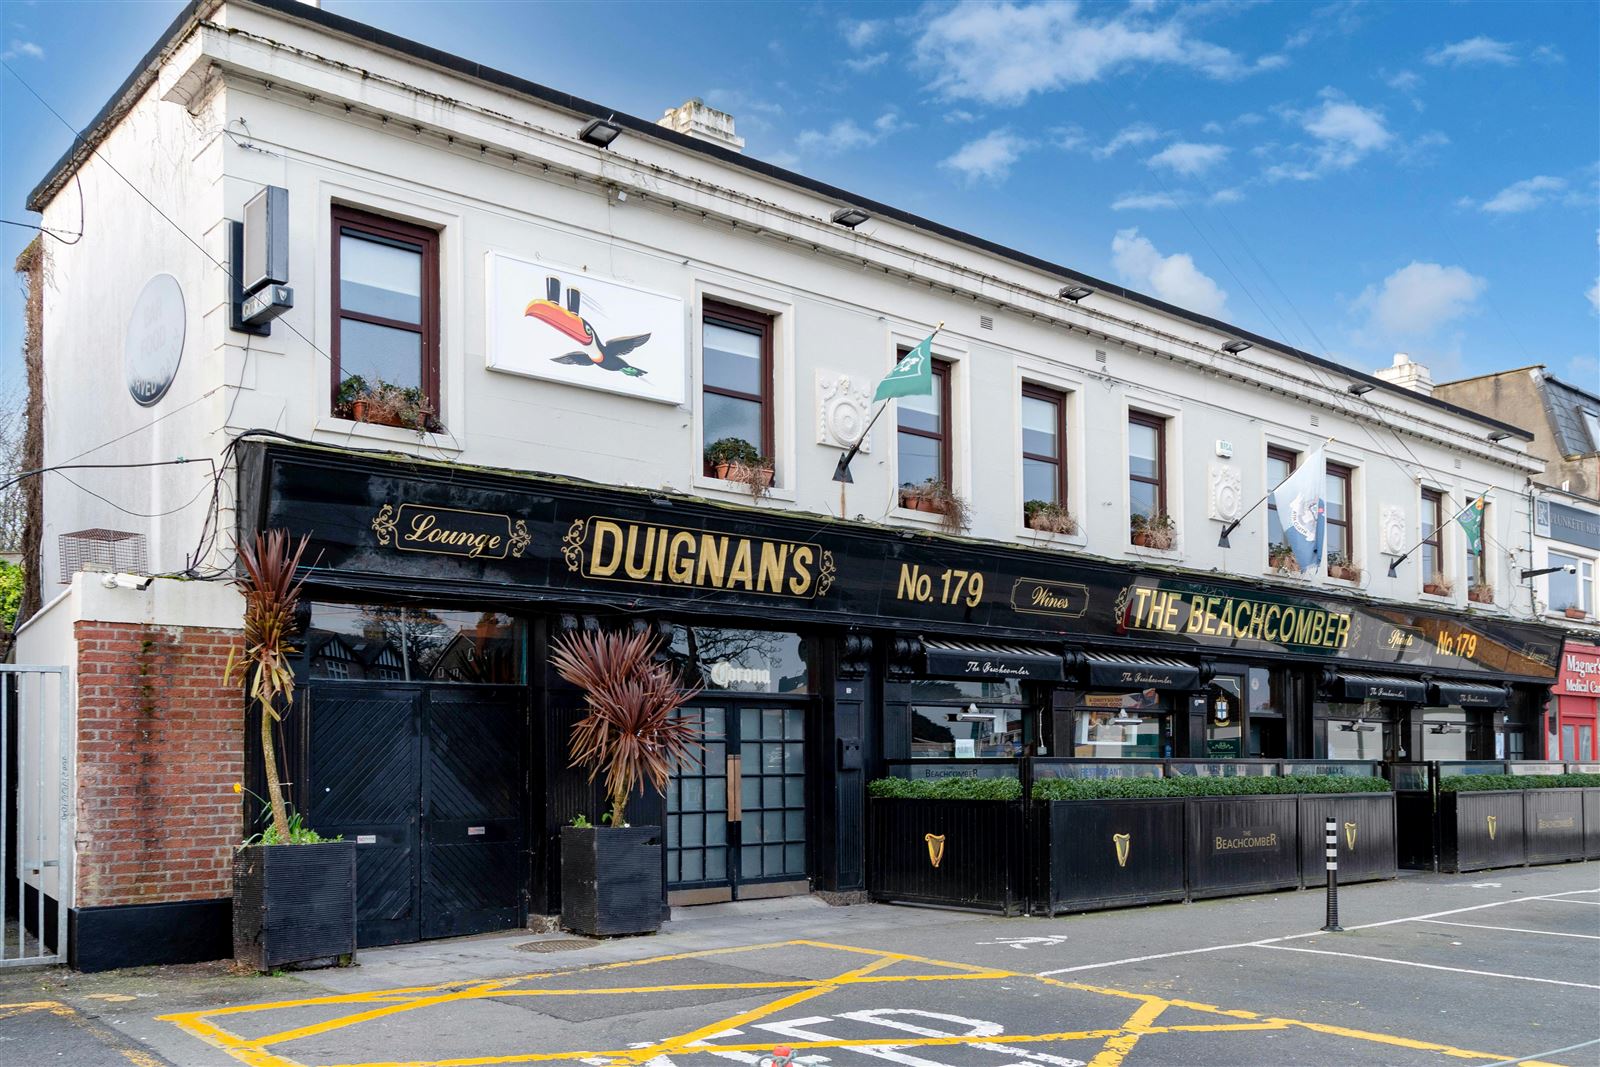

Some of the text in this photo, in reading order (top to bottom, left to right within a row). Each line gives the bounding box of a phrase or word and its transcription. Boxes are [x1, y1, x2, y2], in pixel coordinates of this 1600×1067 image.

[404, 513, 501, 558] Lounge
[589, 520, 813, 596] DUIGNAN'S
[897, 563, 984, 607] No. 179
[1031, 585, 1070, 609] Wines
[1134, 588, 1351, 648] THE BEACHCOMBER
[1436, 630, 1477, 659] No. 179
[965, 661, 1030, 675] The Beachcomber
[1121, 671, 1133, 683] The
[1565, 678, 1589, 692] Medical
[925, 768, 978, 778] BEACHCOMBER
[1215, 833, 1277, 850] BEACHCOMBER
